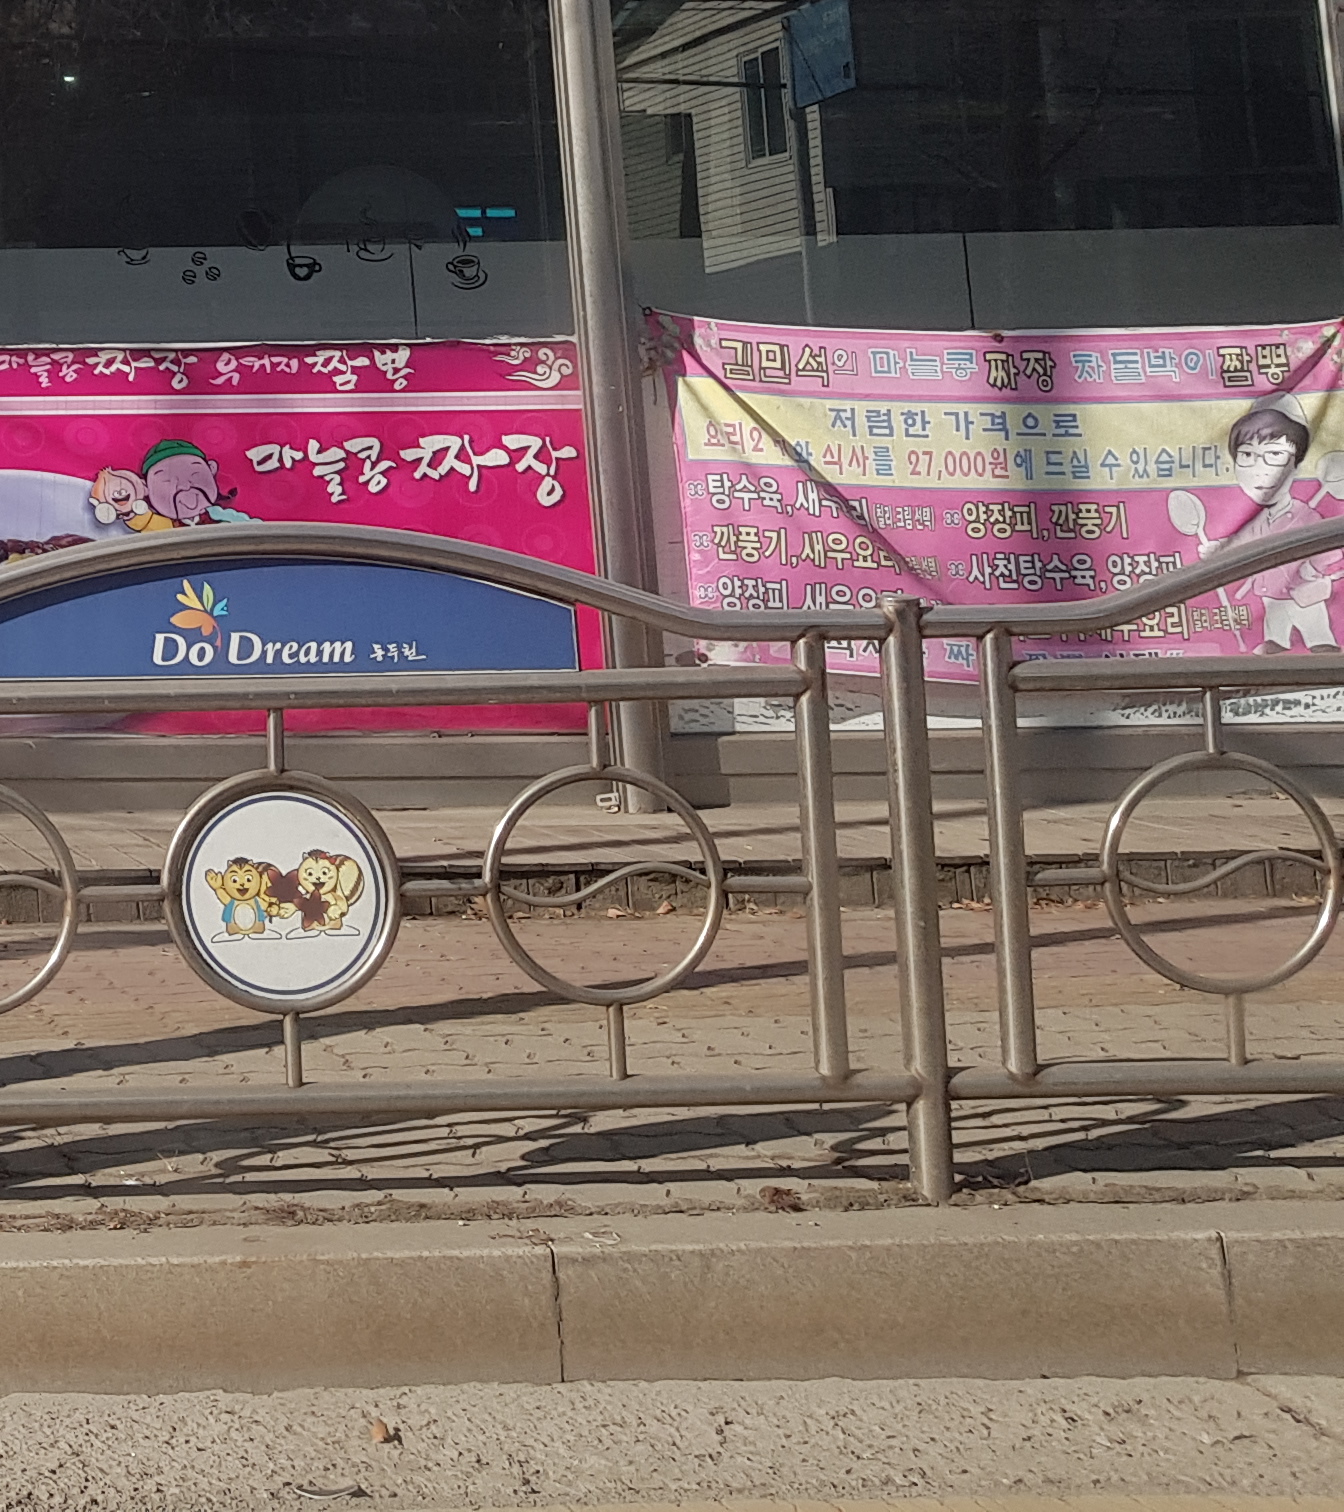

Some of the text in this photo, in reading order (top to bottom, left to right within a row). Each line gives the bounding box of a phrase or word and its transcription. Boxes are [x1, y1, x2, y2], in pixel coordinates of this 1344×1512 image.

[720, 339, 858, 387] 김민석의
[828, 406, 1083, 442] 저렴한 가격으로
[821, 441, 895, 478] 식사를
[1043, 447, 1092, 480] 드실
[1099, 447, 1123, 481] 수
[1129, 444, 1231, 480] 있습니다.
[962, 500, 1130, 540] 양장피,깐풍기
[152, 631, 215, 667] Do
[227, 631, 356, 665] Dream
